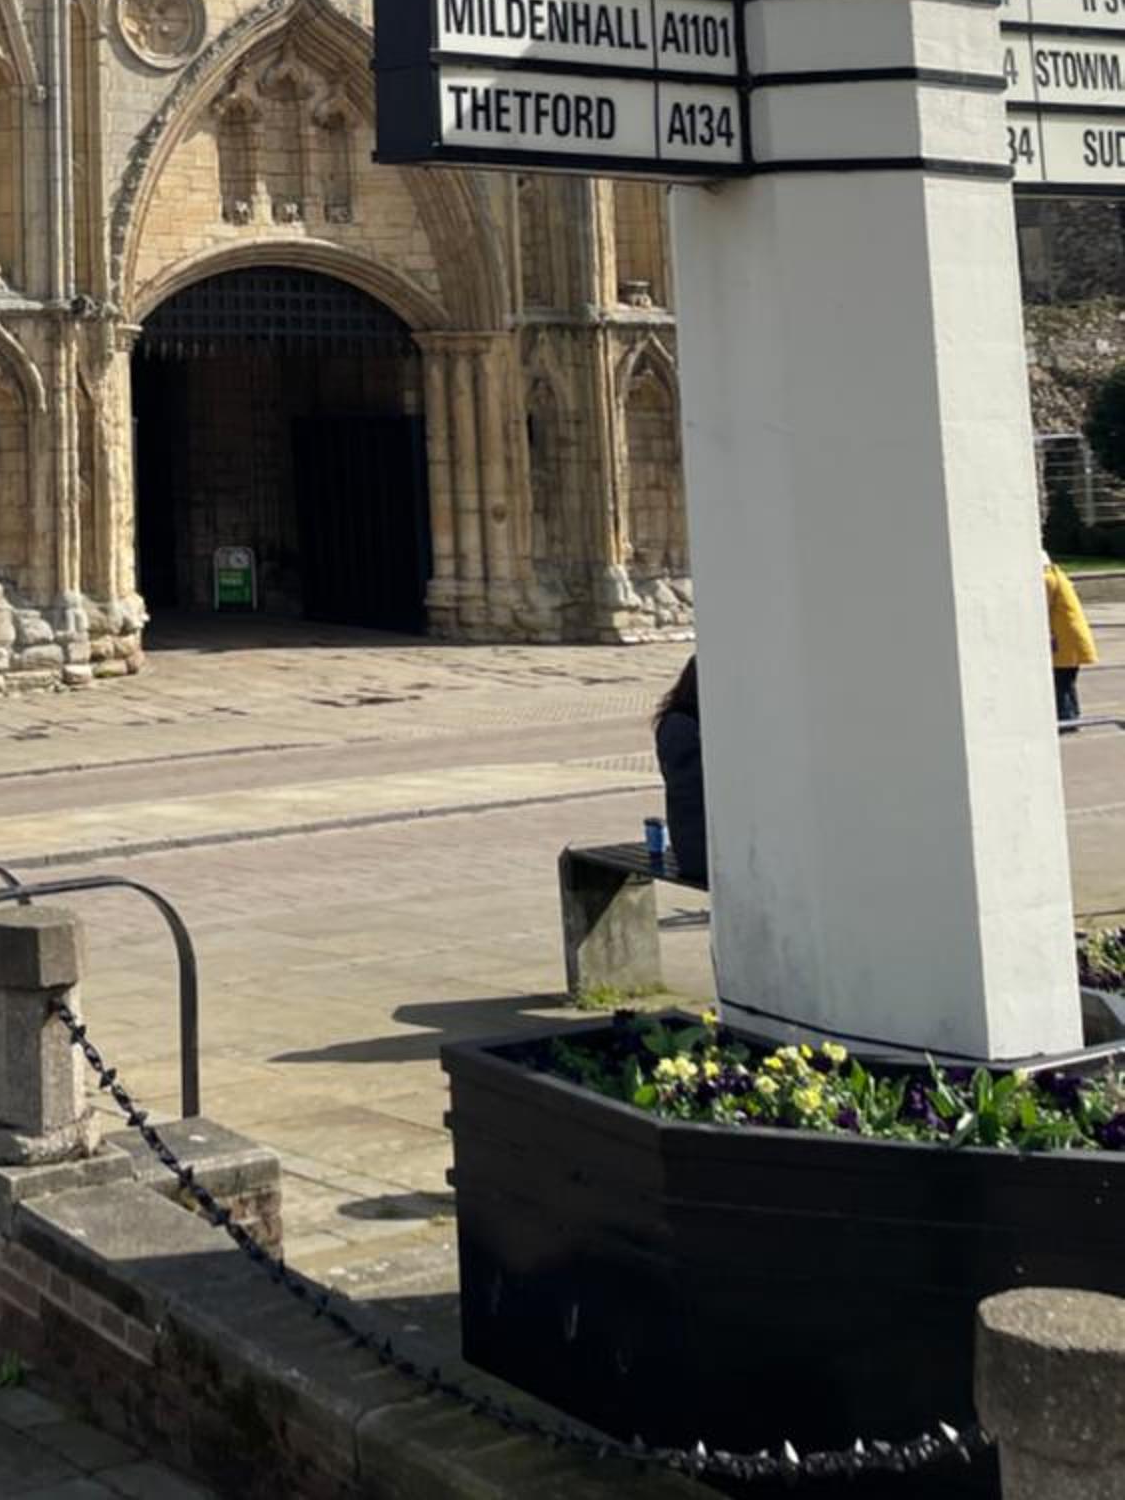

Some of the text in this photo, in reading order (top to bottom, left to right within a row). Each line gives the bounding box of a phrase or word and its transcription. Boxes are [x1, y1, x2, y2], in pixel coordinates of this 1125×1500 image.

[662, 12, 731, 58] A1101
[1036, 49, 1125, 90] STOWM
[449, 86, 735, 147] THETFORD A134
